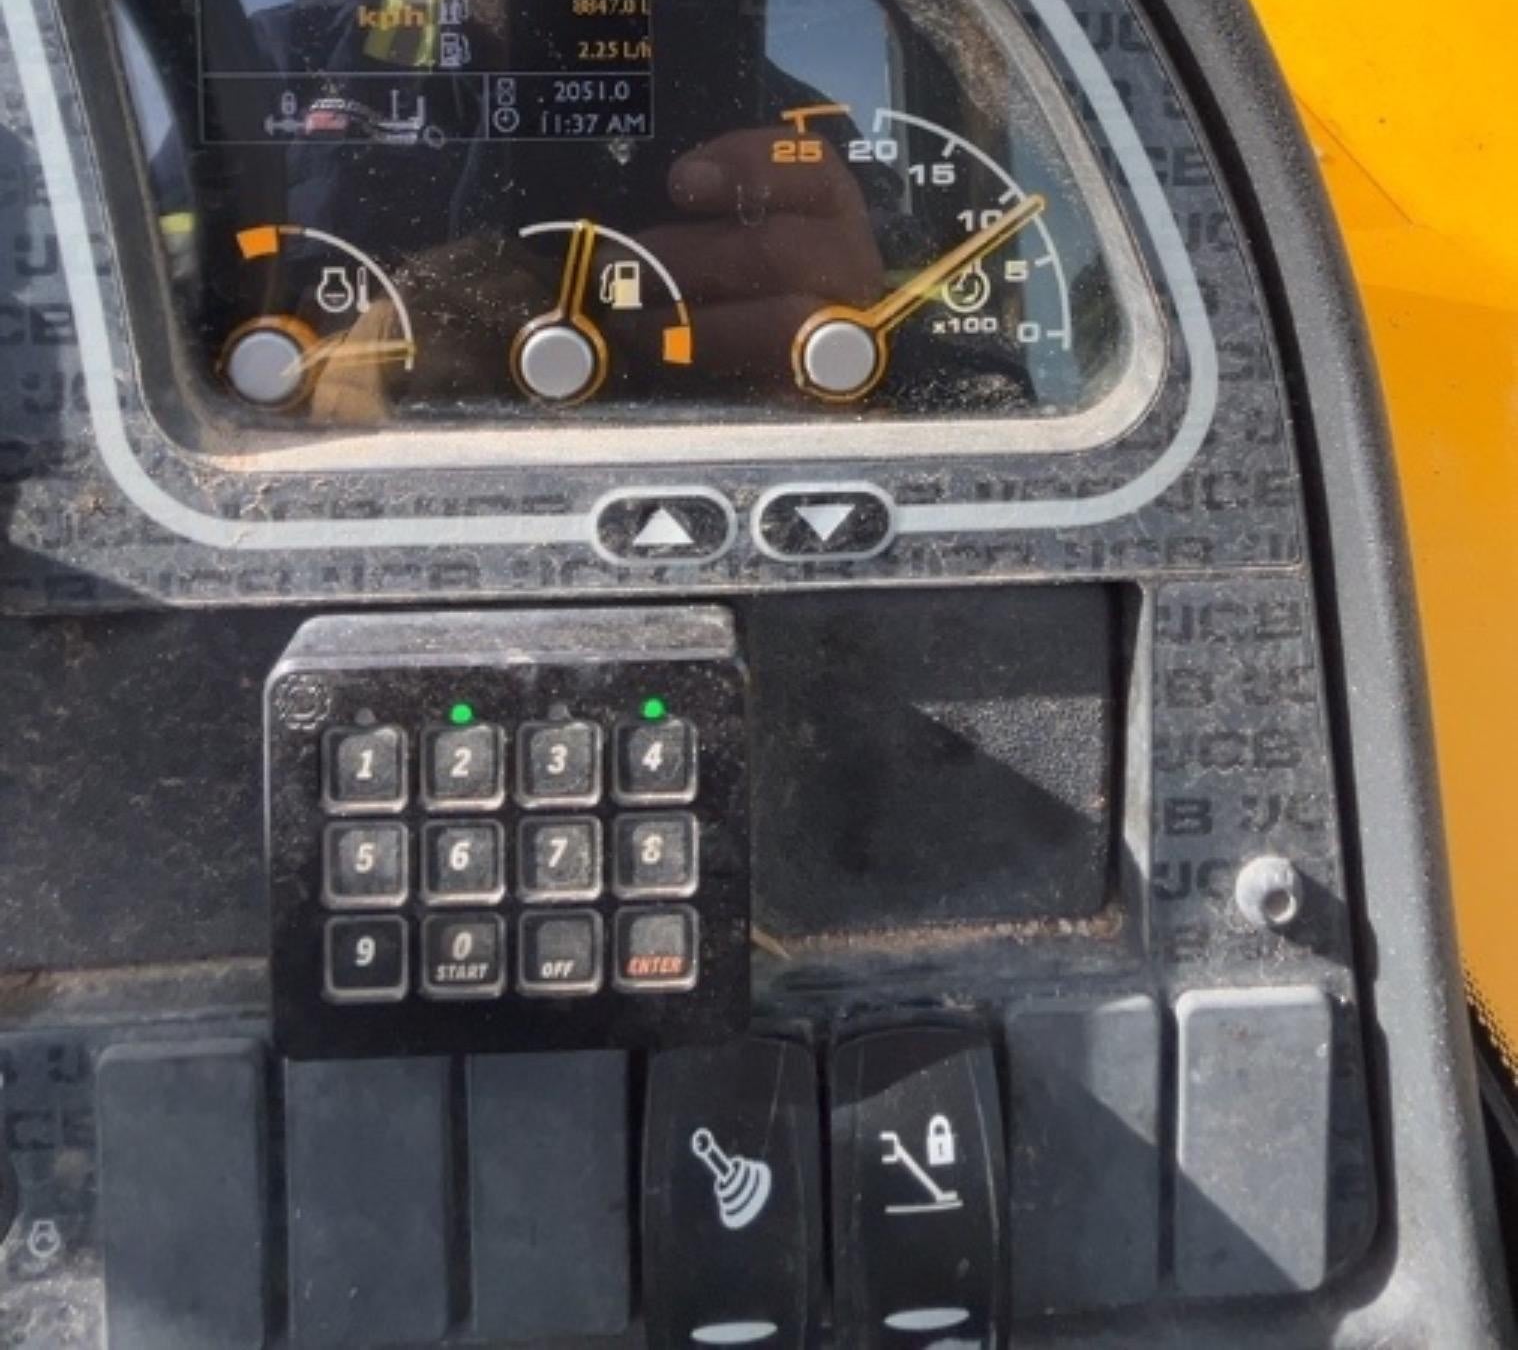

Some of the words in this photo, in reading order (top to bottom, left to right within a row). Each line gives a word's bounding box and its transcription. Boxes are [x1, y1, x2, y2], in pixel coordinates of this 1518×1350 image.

[357, 5, 424, 31] kph
[553, 80, 631, 102] 2051.0
[606, 113, 647, 134] AM
[771, 140, 822, 162] 25
[848, 140, 898, 161] 20
[908, 163, 956, 185] 15
[956, 209, 1004, 233] 10
[1004, 260, 1028, 282] 5
[932, 316, 998, 334] x100
[1016, 324, 1040, 345] 0
[356, 748, 374, 781] 1
[451, 746, 472, 778] 2
[547, 742, 568, 775] 3
[641, 740, 663, 772] 4
[355, 841, 376, 874] 5
[450, 839, 471, 871] 6
[548, 836, 568, 868] 7
[641, 834, 663, 864] 8
[355, 935, 376, 968] 9
[452, 931, 473, 961] 0
[436, 963, 488, 982] START
[541, 959, 576, 979] OFF
[627, 956, 683, 976] ENTER
